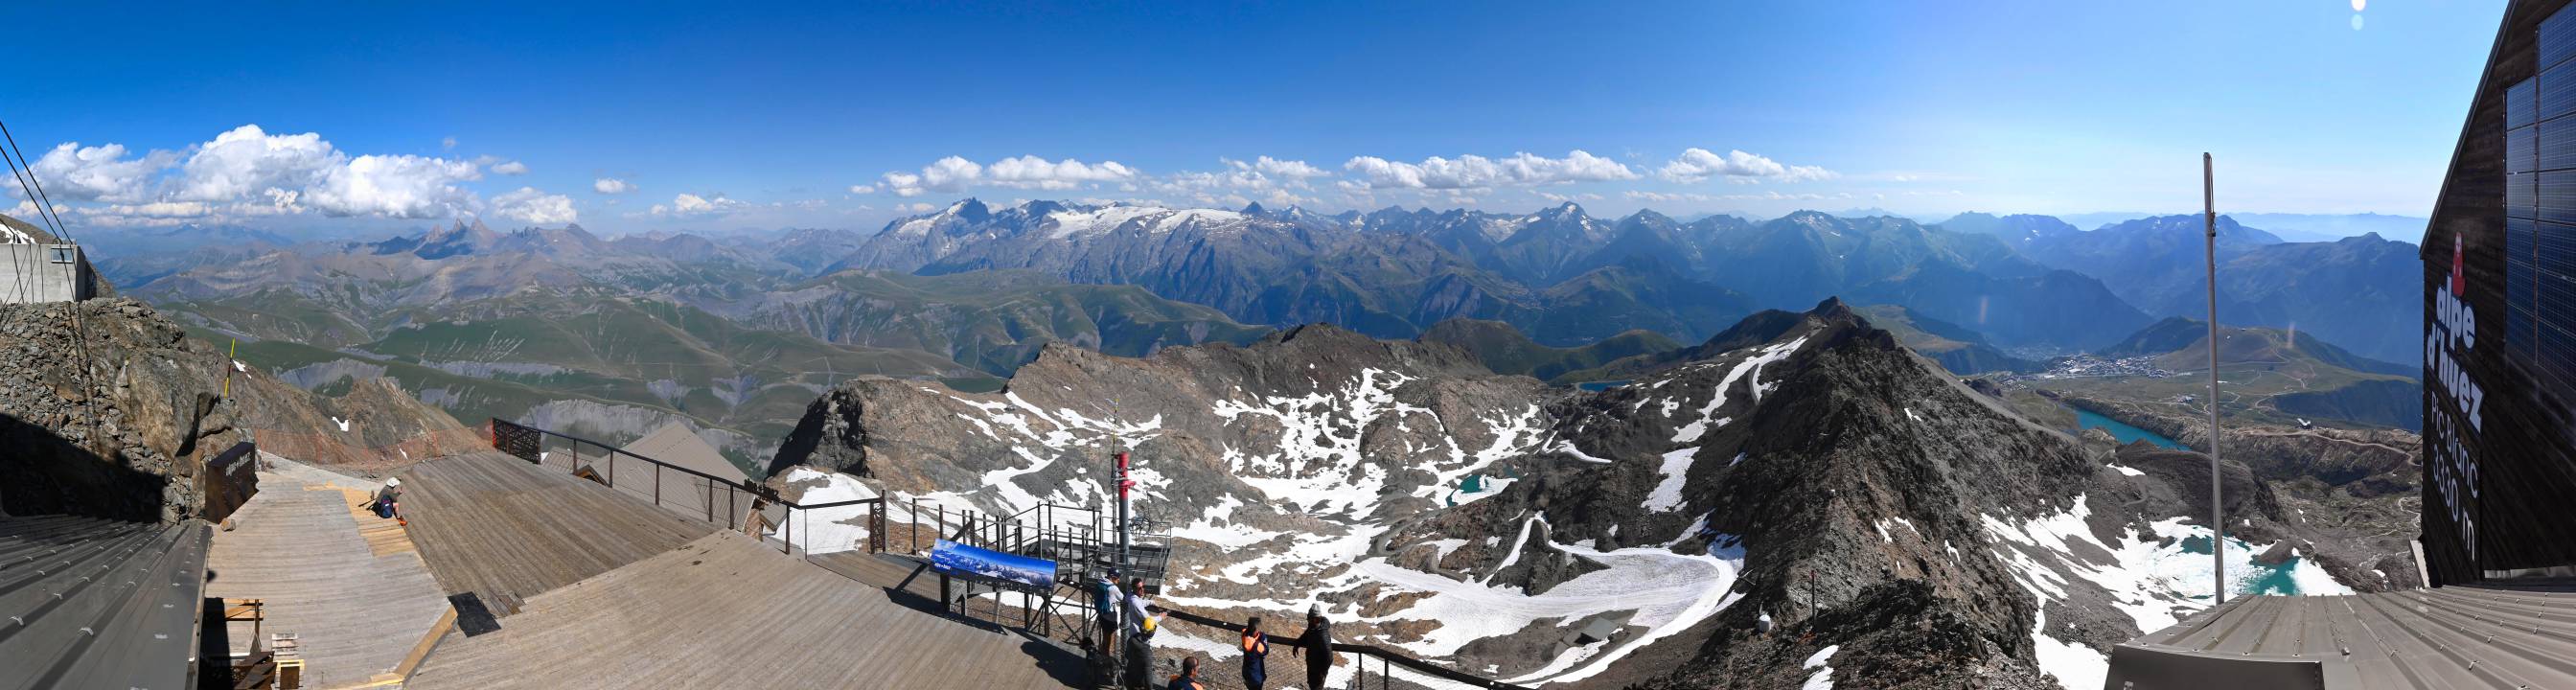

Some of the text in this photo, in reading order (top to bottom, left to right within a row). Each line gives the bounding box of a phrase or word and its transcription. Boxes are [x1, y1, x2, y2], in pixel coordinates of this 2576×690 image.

[2437, 276, 2475, 349] alpe
[2426, 322, 2483, 433] d'huez
[2431, 391, 2478, 498] Pic Blanc
[2433, 444, 2474, 562] 3330 m
